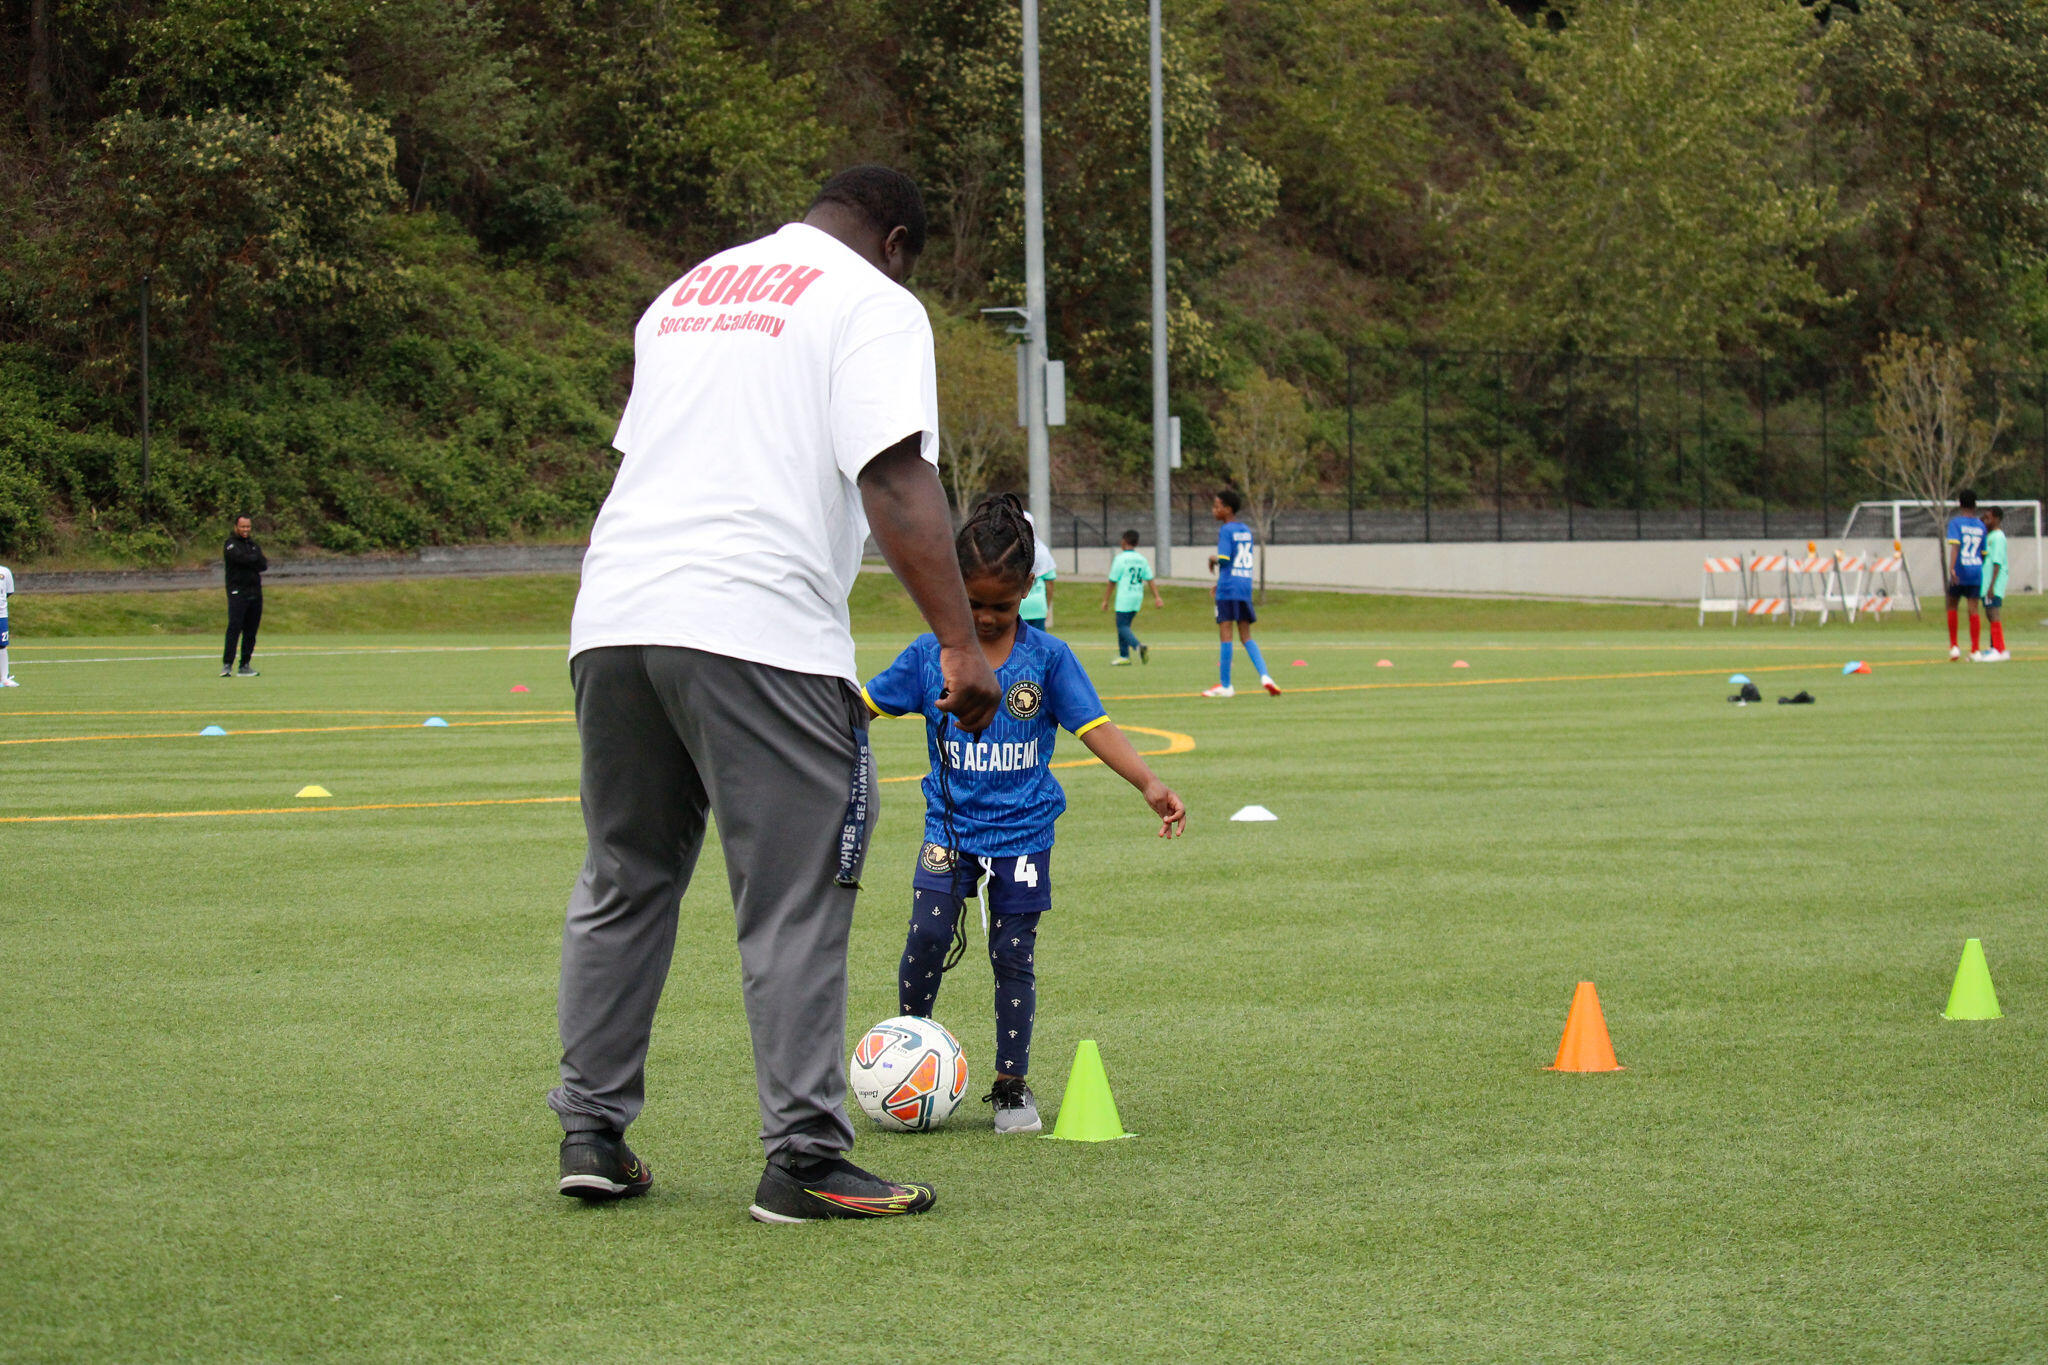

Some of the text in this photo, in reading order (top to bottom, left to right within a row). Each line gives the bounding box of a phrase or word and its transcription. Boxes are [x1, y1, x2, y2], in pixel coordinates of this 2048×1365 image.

[672, 264, 824, 307] COACH
[657, 310, 785, 338] Soccer Academy
[1961, 535, 1982, 558] 27
[1008, 683, 1028, 701] AFRICAN
[856, 745, 868, 821] SEAHAWKS
[1013, 855, 1039, 888] 4
